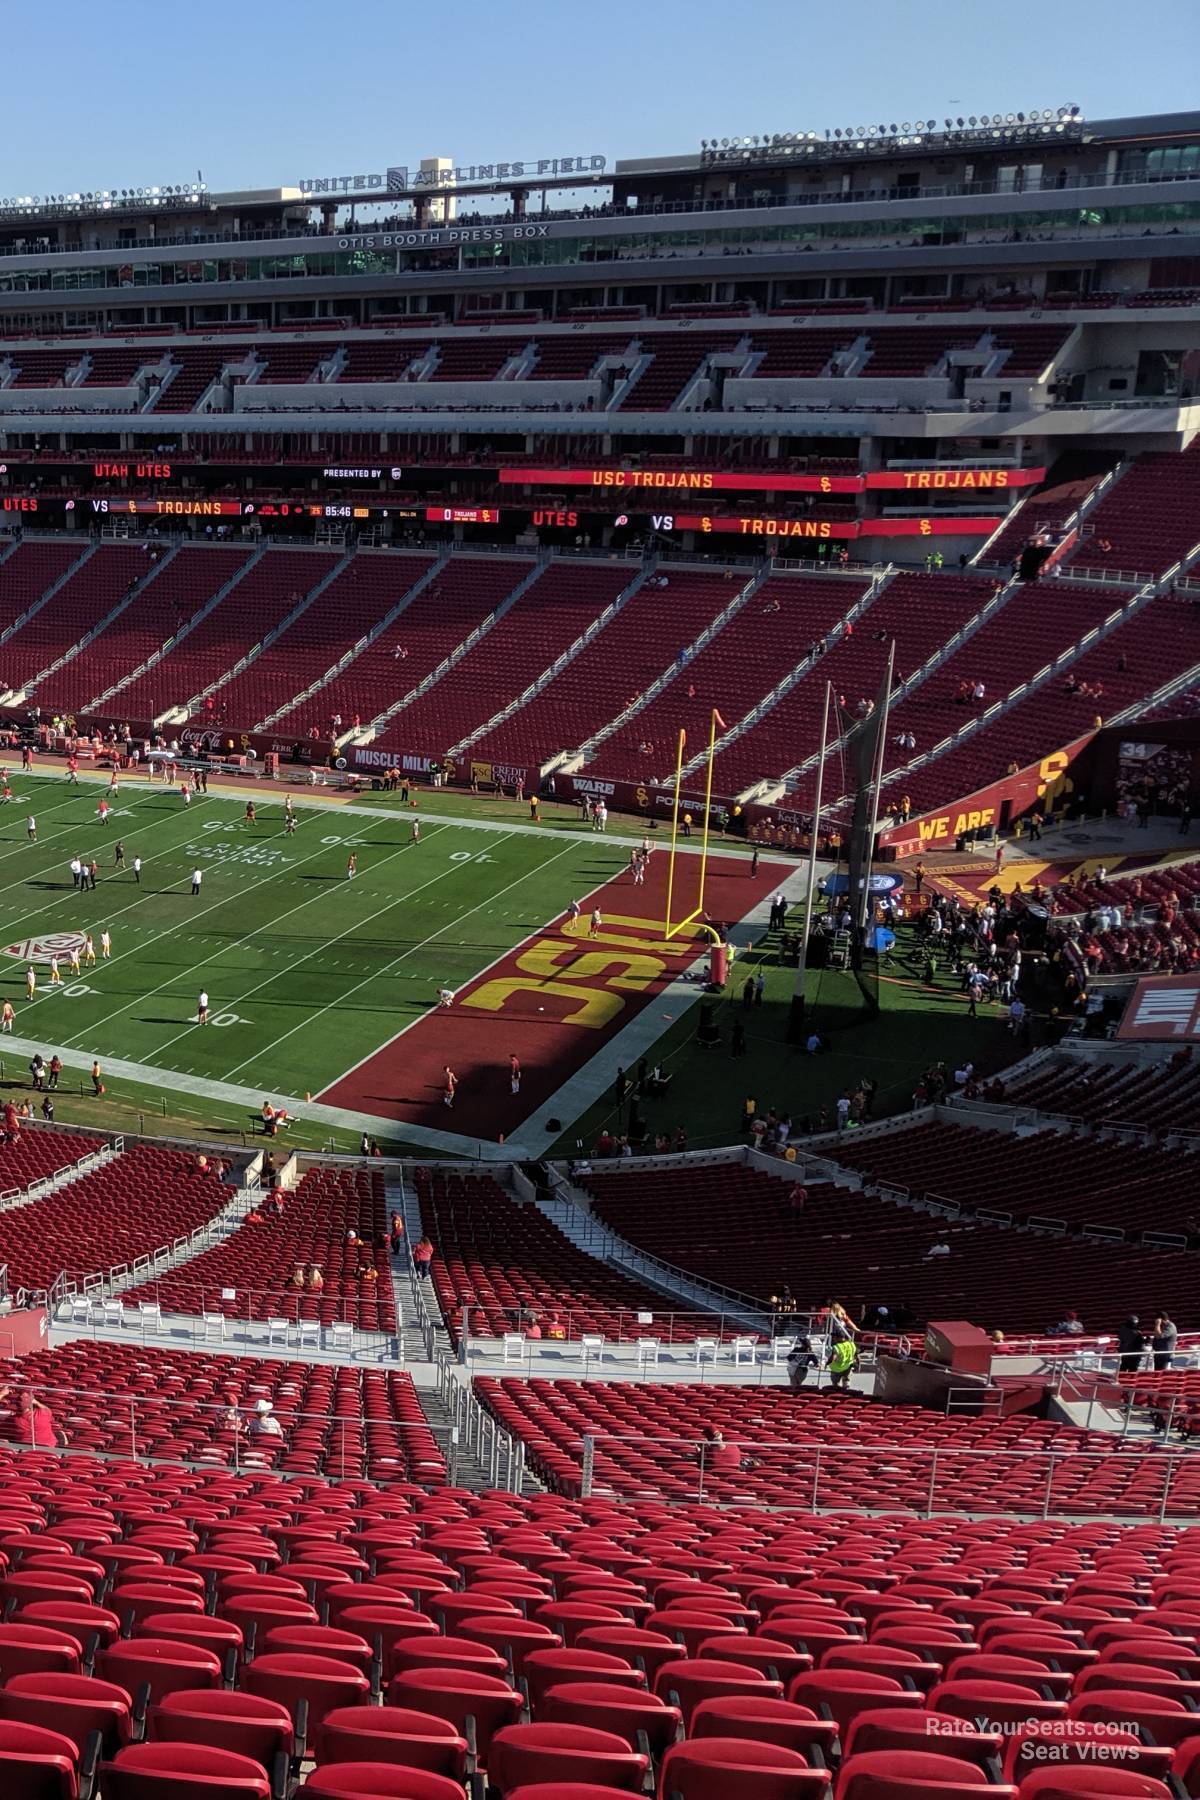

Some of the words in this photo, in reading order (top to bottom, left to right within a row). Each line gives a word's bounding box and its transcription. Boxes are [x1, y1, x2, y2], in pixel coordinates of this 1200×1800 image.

[300, 174, 381, 194] UNITED
[413, 162, 524, 185] AIRLINES
[537, 155, 607, 175] FIELD
[338, 237, 374, 249] OTIS
[383, 232, 440, 247] BOOTH
[450, 229, 504, 242] PRESS
[514, 225, 551, 238] BOX
[95, 464, 128, 477] UTAH
[137, 465, 171, 477] UTES
[324, 469, 369, 478] PRESENTED
[371, 470, 382, 478] BY
[593, 472, 625, 485] USC
[632, 472, 713, 488] TROJANS
[904, 472, 1008, 488] TROJANS
[3, 499, 37, 511] UTES
[93, 500, 108, 512] VS
[156, 501, 221, 514] TROJANS
[325, 506, 351, 517] 85:46
[444, 508, 451, 520] 0
[533, 511, 577, 526] UTES
[652, 516, 673, 530] VS
[740, 519, 831, 537] TROJANS
[1123, 743, 1146, 757] 34
[355, 750, 399, 768] MUSCLE
[403, 756, 431, 772] MILK
[492, 766, 528, 777] CREDIT
[572, 778, 615, 795] WARE
[919, 817, 949, 841] WE
[953, 809, 995, 835] ARE
[459, 913, 710, 1029] USC
